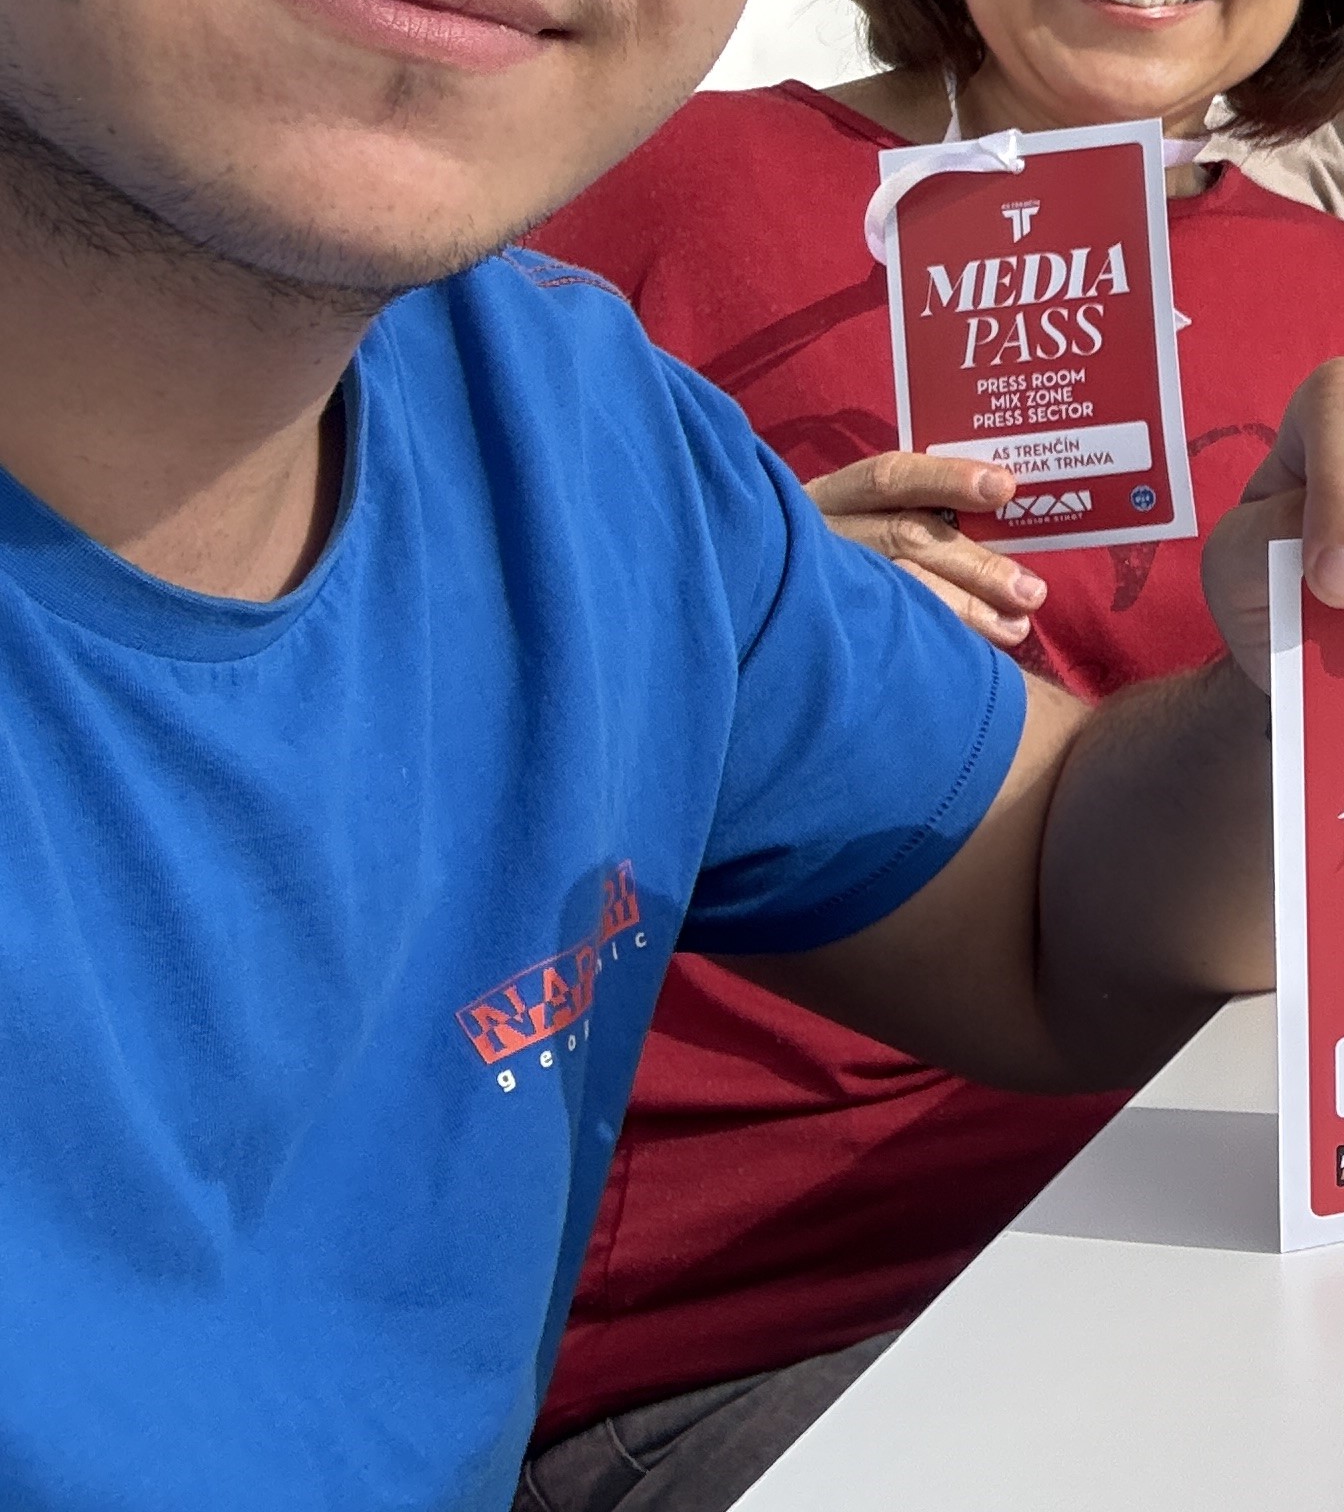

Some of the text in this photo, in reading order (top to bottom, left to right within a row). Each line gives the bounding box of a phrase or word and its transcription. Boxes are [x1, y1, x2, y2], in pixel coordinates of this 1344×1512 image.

[920, 242, 1130, 317] MEDIA
[960, 304, 1105, 370] PASS
[977, 367, 1086, 395] PRESS ROOM
[991, 387, 1073, 410] MIX ZONE
[973, 402, 1094, 430] PRESS SECTOR
[992, 446, 1010, 461] AS
[1054, 451, 1114, 470] TRNAVA
